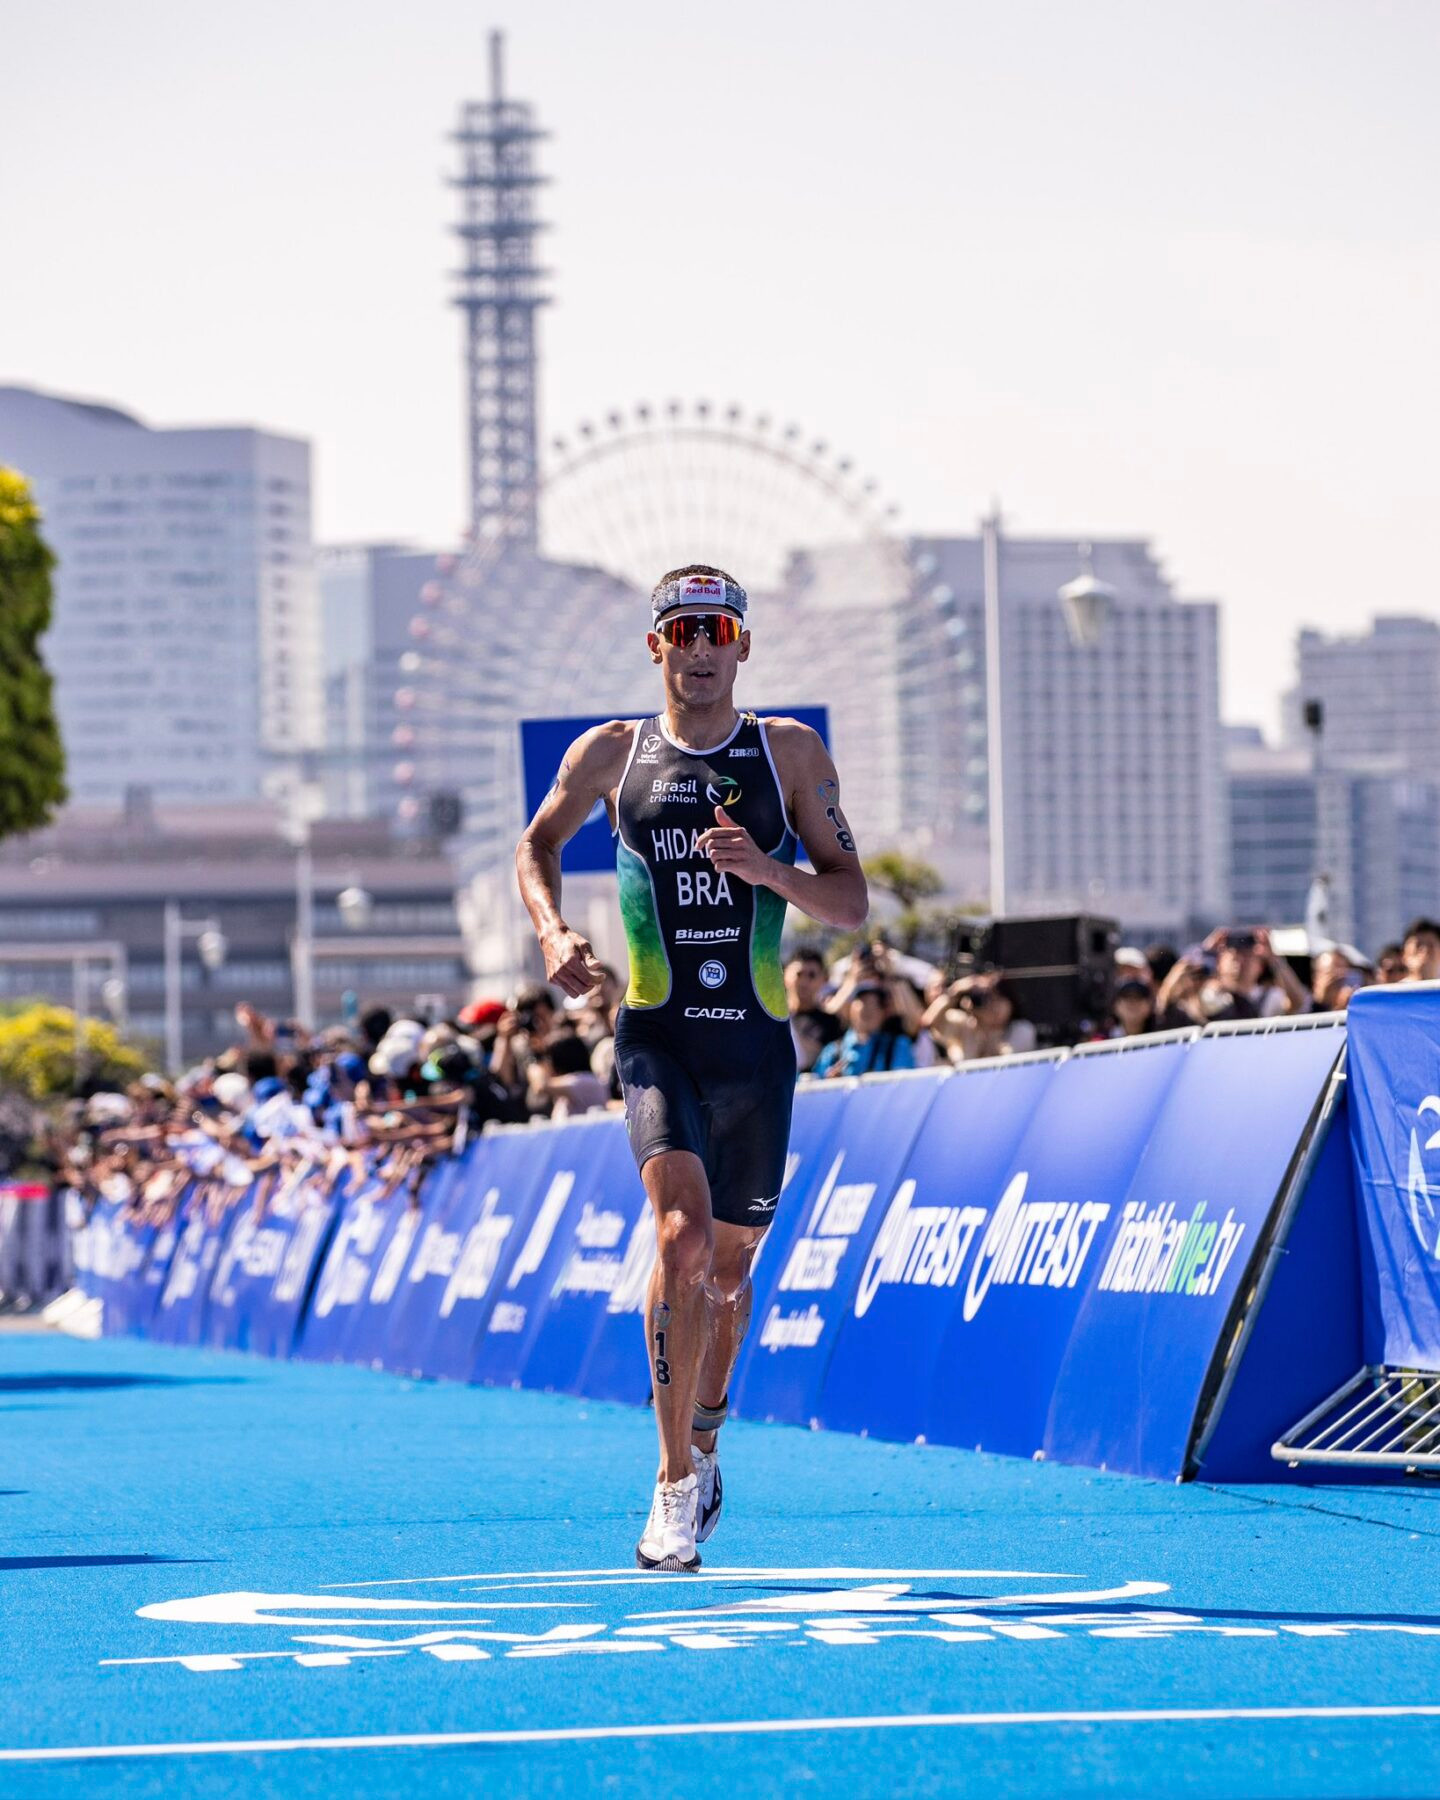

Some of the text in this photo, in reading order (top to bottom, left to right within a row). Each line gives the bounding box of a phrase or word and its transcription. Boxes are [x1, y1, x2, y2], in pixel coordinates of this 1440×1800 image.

[652, 780, 697, 793] Brasil
[650, 794, 697, 804] triathlon
[676, 871, 734, 906] BRA
[675, 927, 741, 939] Bianchi
[684, 1007, 747, 1020] CADEX
[654, 1331, 672, 1386] 18
[290, 1611, 1203, 1648] World
